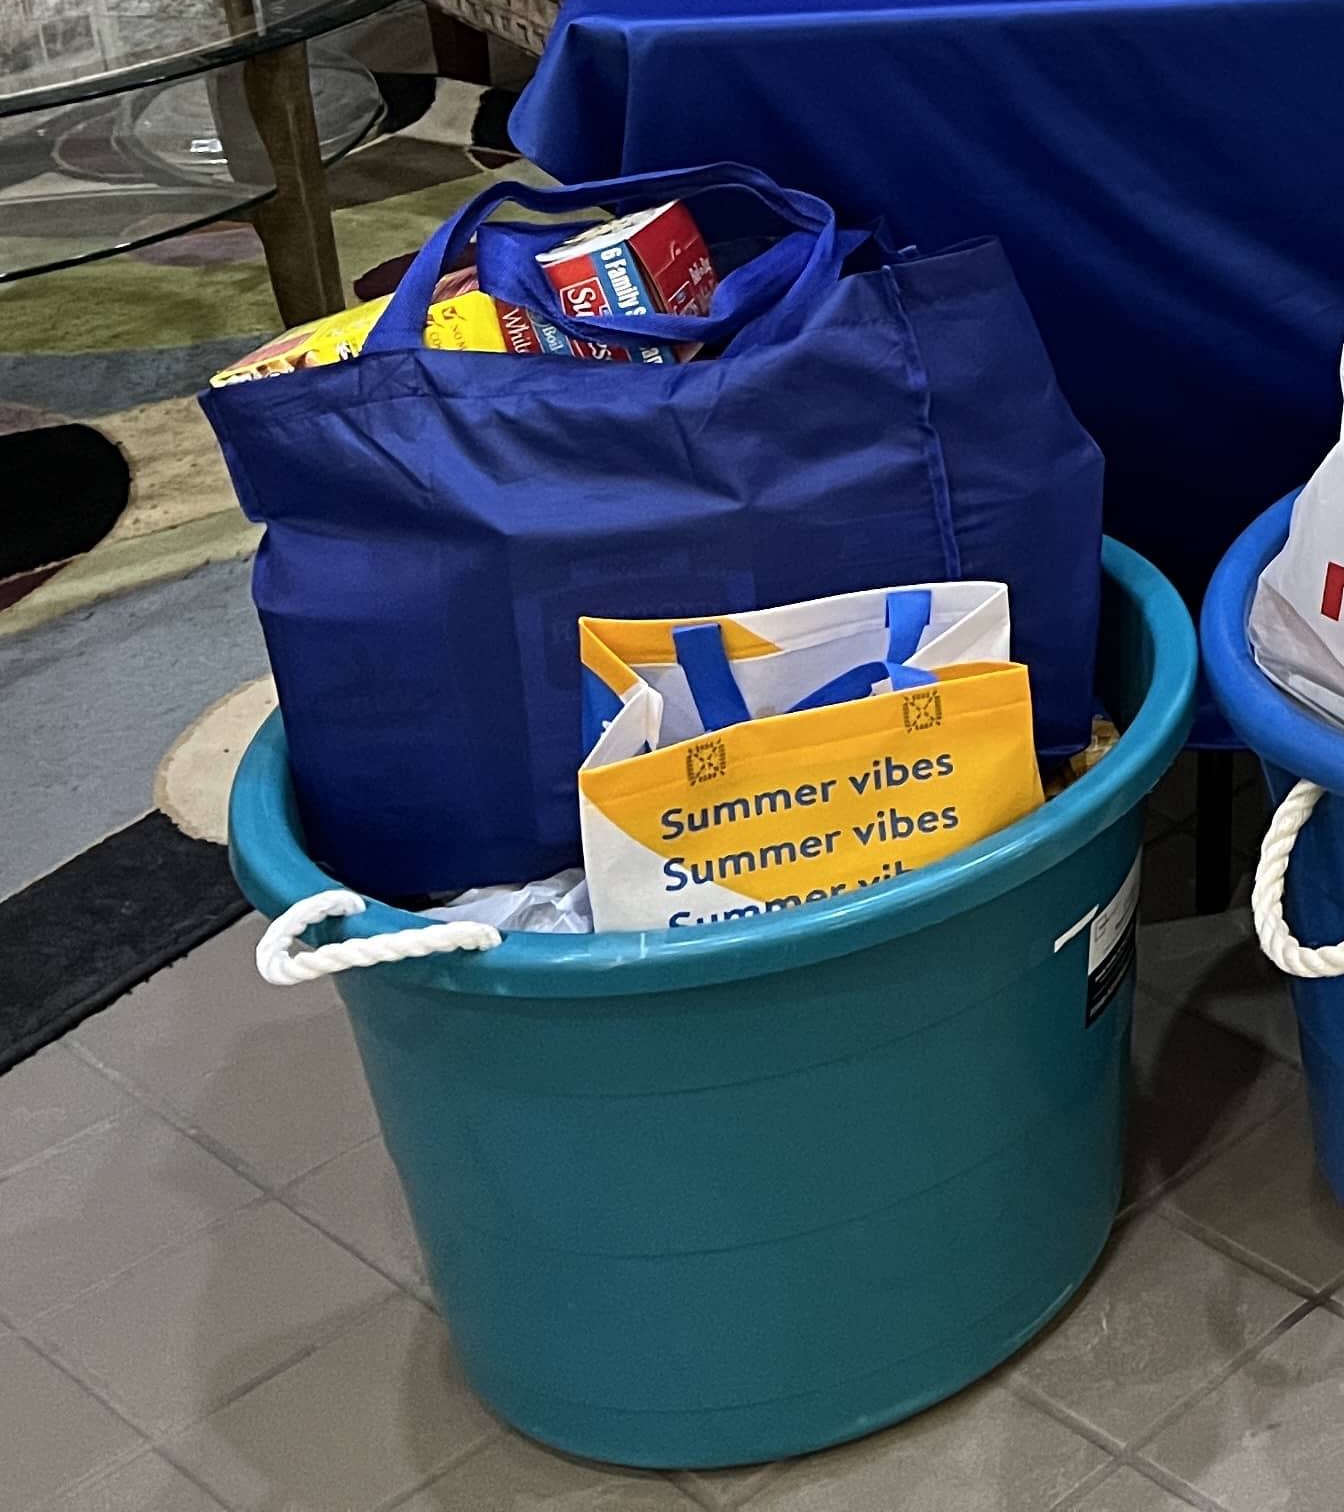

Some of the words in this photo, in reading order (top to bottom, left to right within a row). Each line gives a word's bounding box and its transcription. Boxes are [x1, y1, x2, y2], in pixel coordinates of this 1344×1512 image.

[600, 247, 622, 261] 6
[602, 259, 641, 308] Family
[661, 774, 837, 841] Summer
[848, 750, 955, 794] vibes
[663, 829, 842, 892] Summer
[851, 803, 960, 848] vibes
